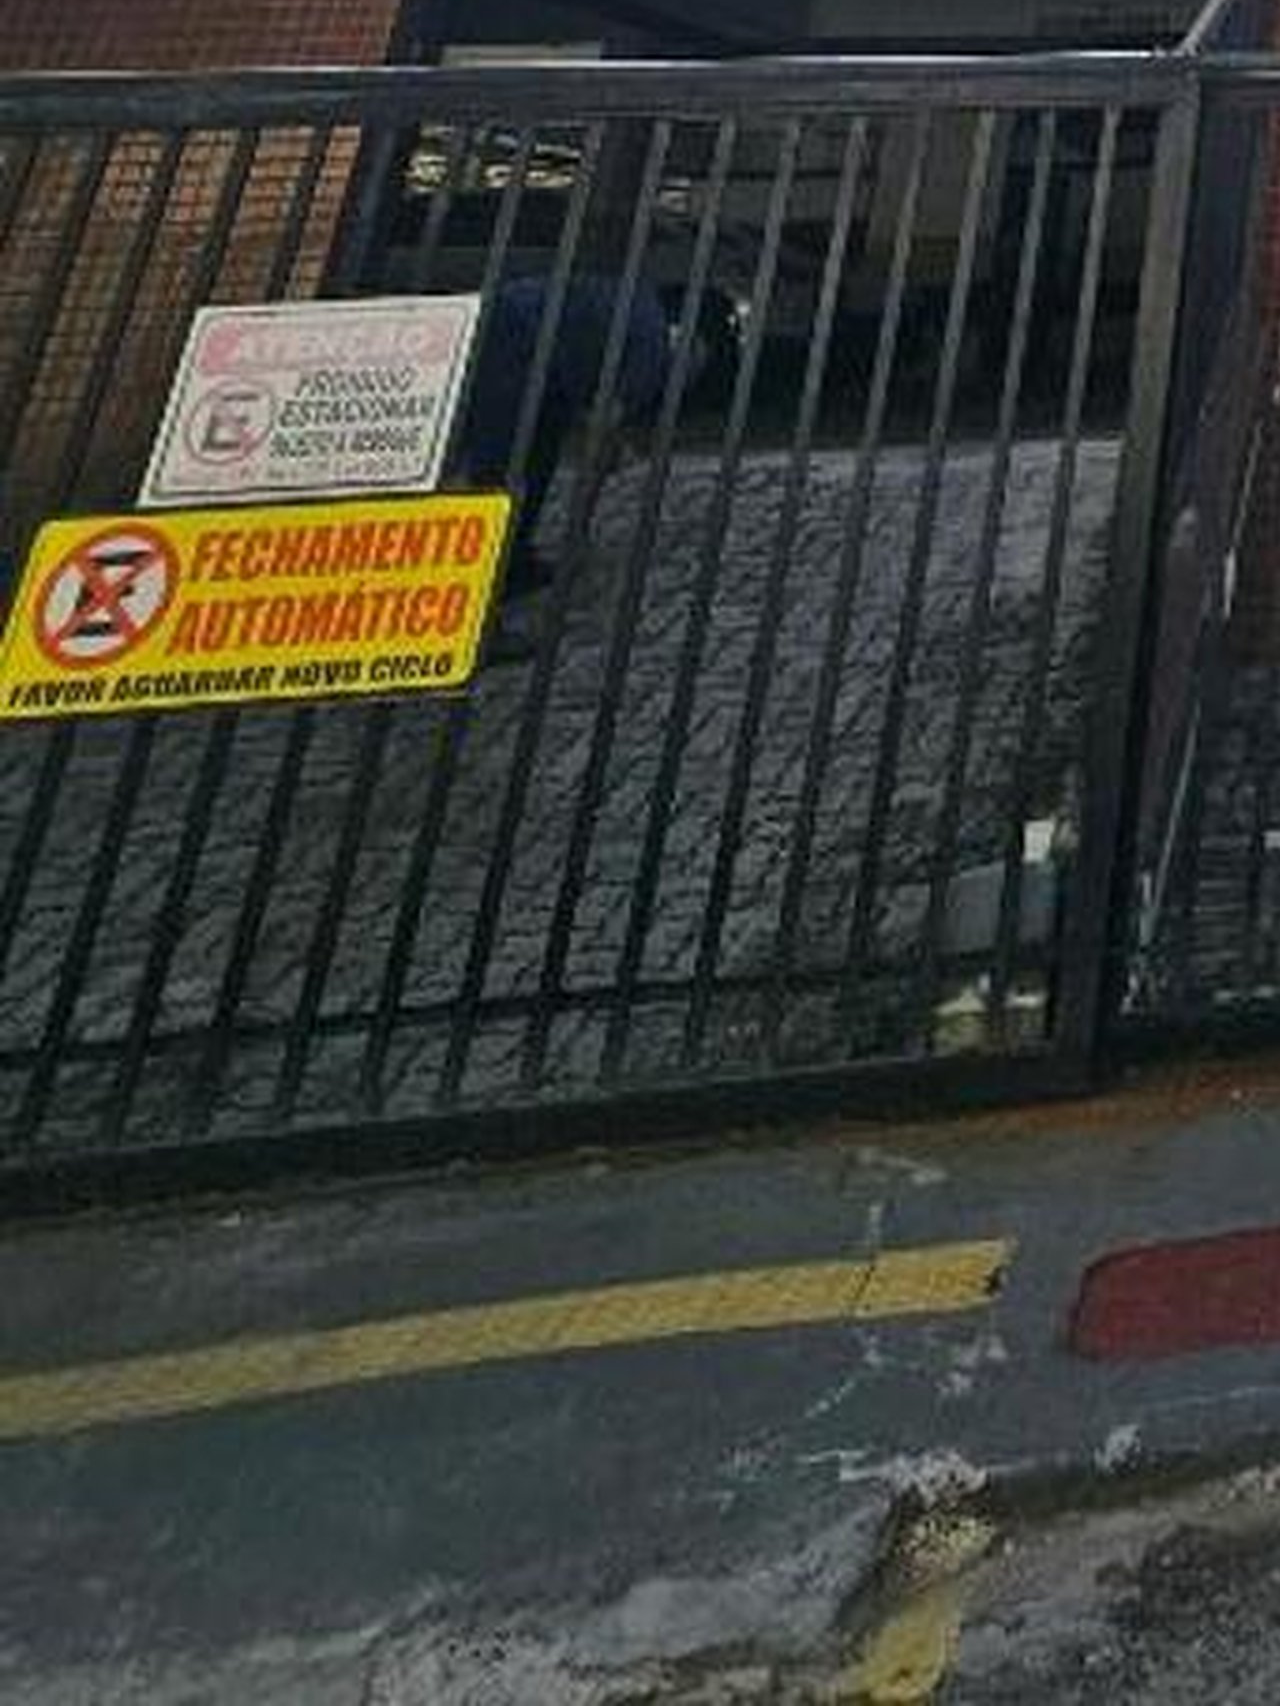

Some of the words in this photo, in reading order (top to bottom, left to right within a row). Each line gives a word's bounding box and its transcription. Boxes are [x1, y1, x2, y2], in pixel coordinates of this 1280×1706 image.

[190, 515, 485, 581] FECHAMENTO
[165, 581, 470, 655] AUTOMÁTICO
[9, 675, 107, 707] FAVOR
[110, 665, 275, 701] AGUARDAR
[280, 658, 362, 691] NOVO
[369, 653, 454, 684] CICLO
